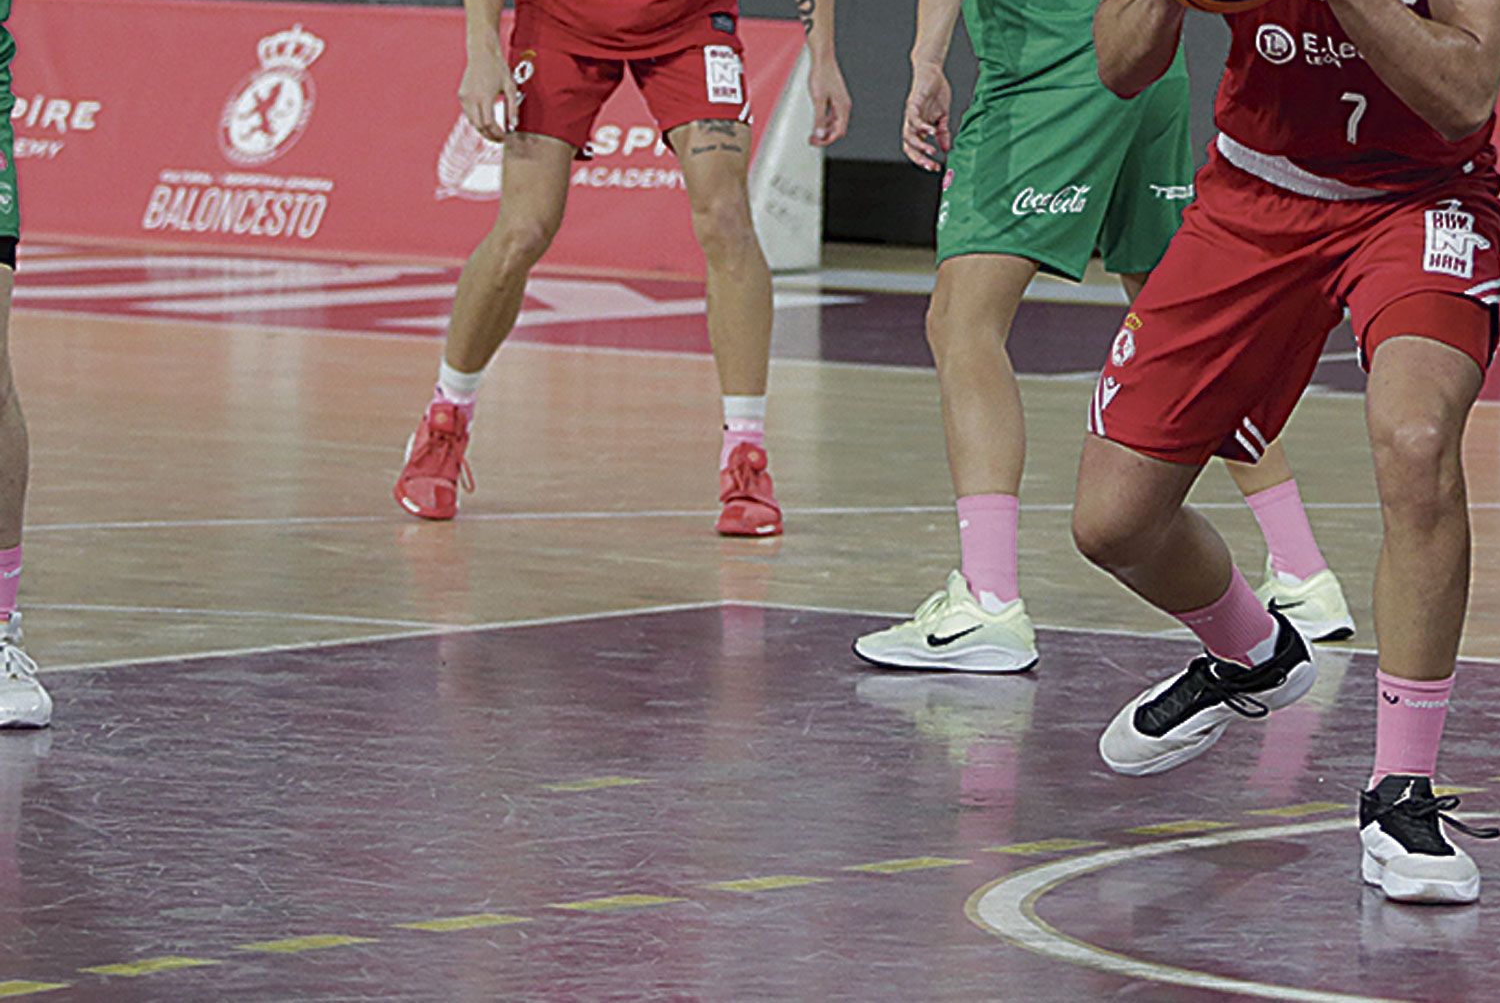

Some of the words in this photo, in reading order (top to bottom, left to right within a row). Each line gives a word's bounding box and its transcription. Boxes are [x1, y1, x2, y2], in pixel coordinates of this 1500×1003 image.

[1302, 31, 1365, 61] E.Le
[11, 94, 101, 134] PIRE
[1340, 91, 1368, 145] 7
[13, 138, 64, 159] EMY
[142, 185, 328, 239] BALONCESTO
[1428, 253, 1467, 274] HAM
